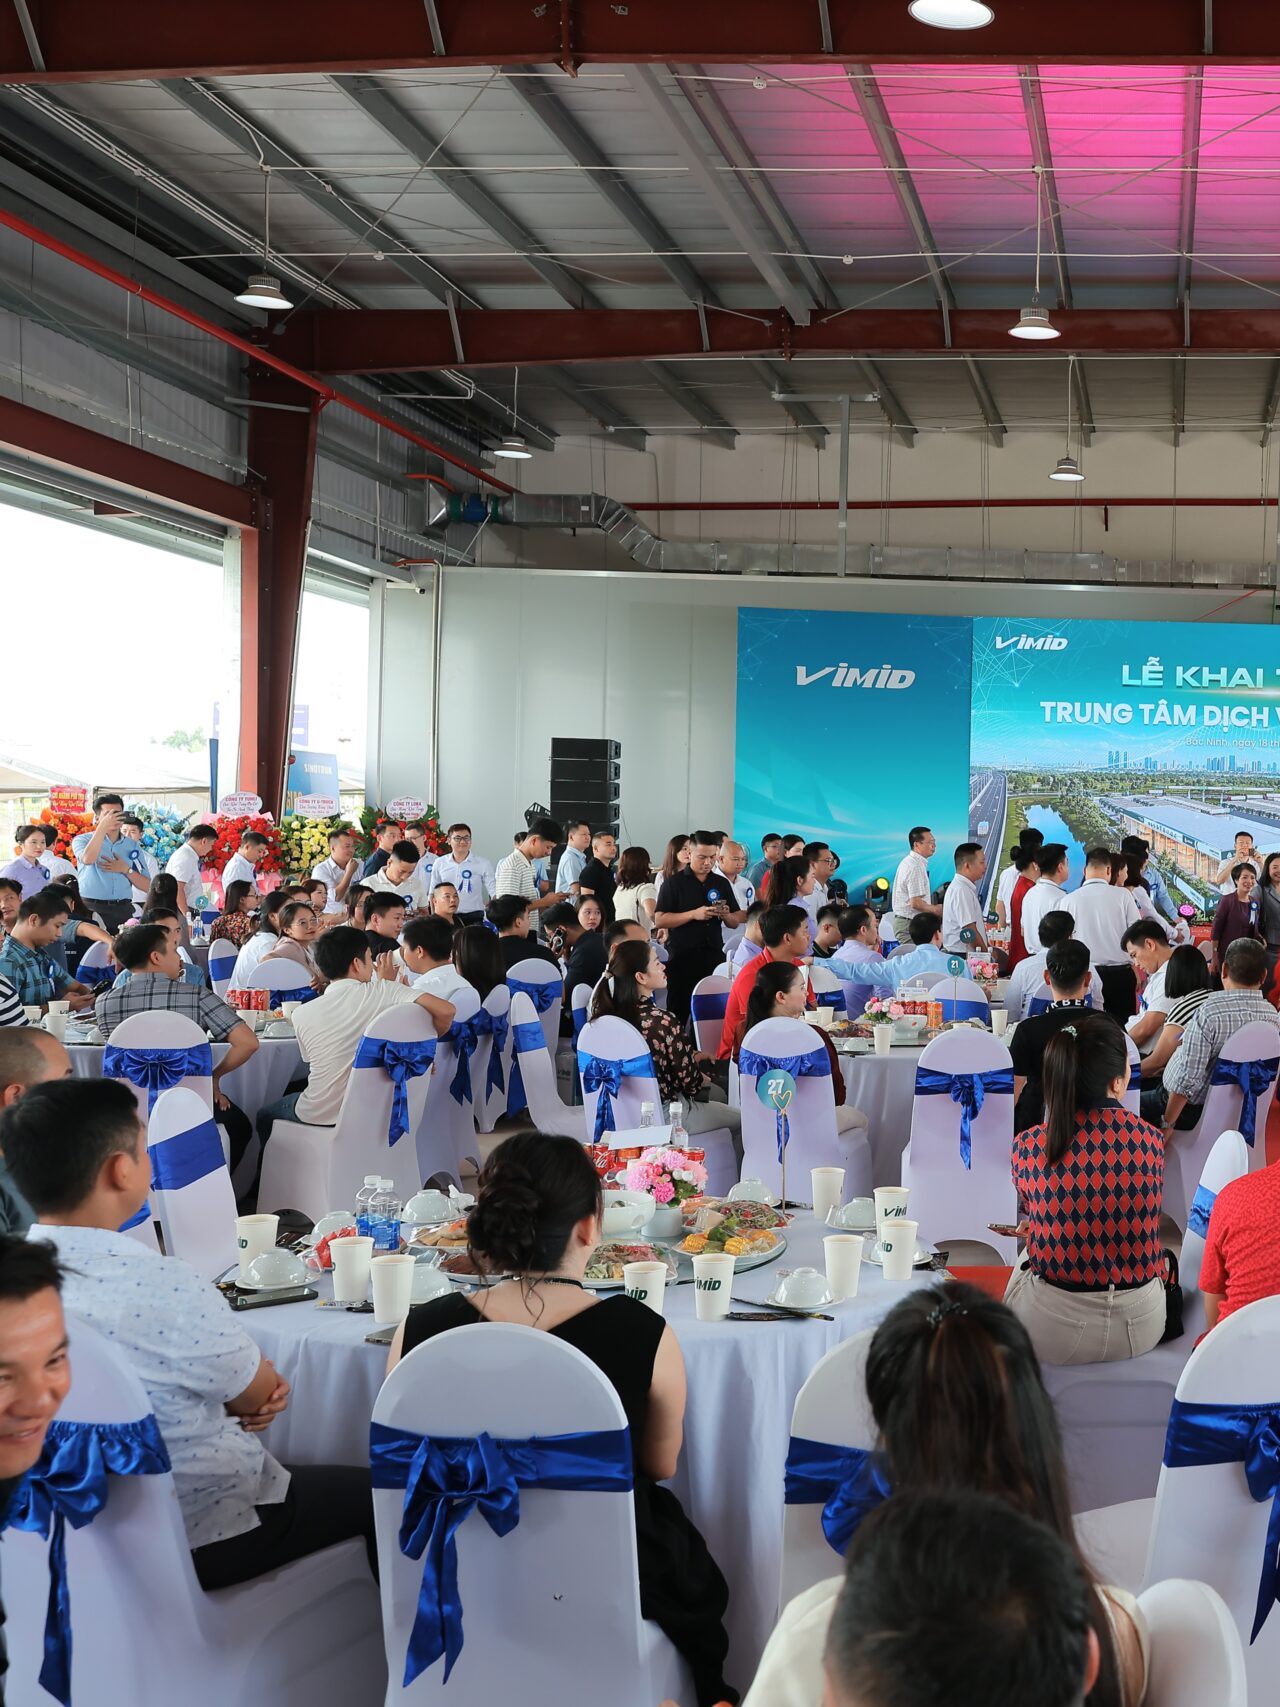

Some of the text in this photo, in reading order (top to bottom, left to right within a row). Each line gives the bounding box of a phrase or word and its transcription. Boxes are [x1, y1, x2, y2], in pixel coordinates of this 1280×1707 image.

[1122, 656, 1164, 687] LỄ
[1175, 666, 1264, 689] KHAI
[1040, 701, 1133, 724] TRUNG
[1139, 699, 1197, 726] TÂM
[1203, 705, 1269, 733] DỊCH
[951, 960, 959, 969] 21
[767, 1079, 784, 1095] 27
